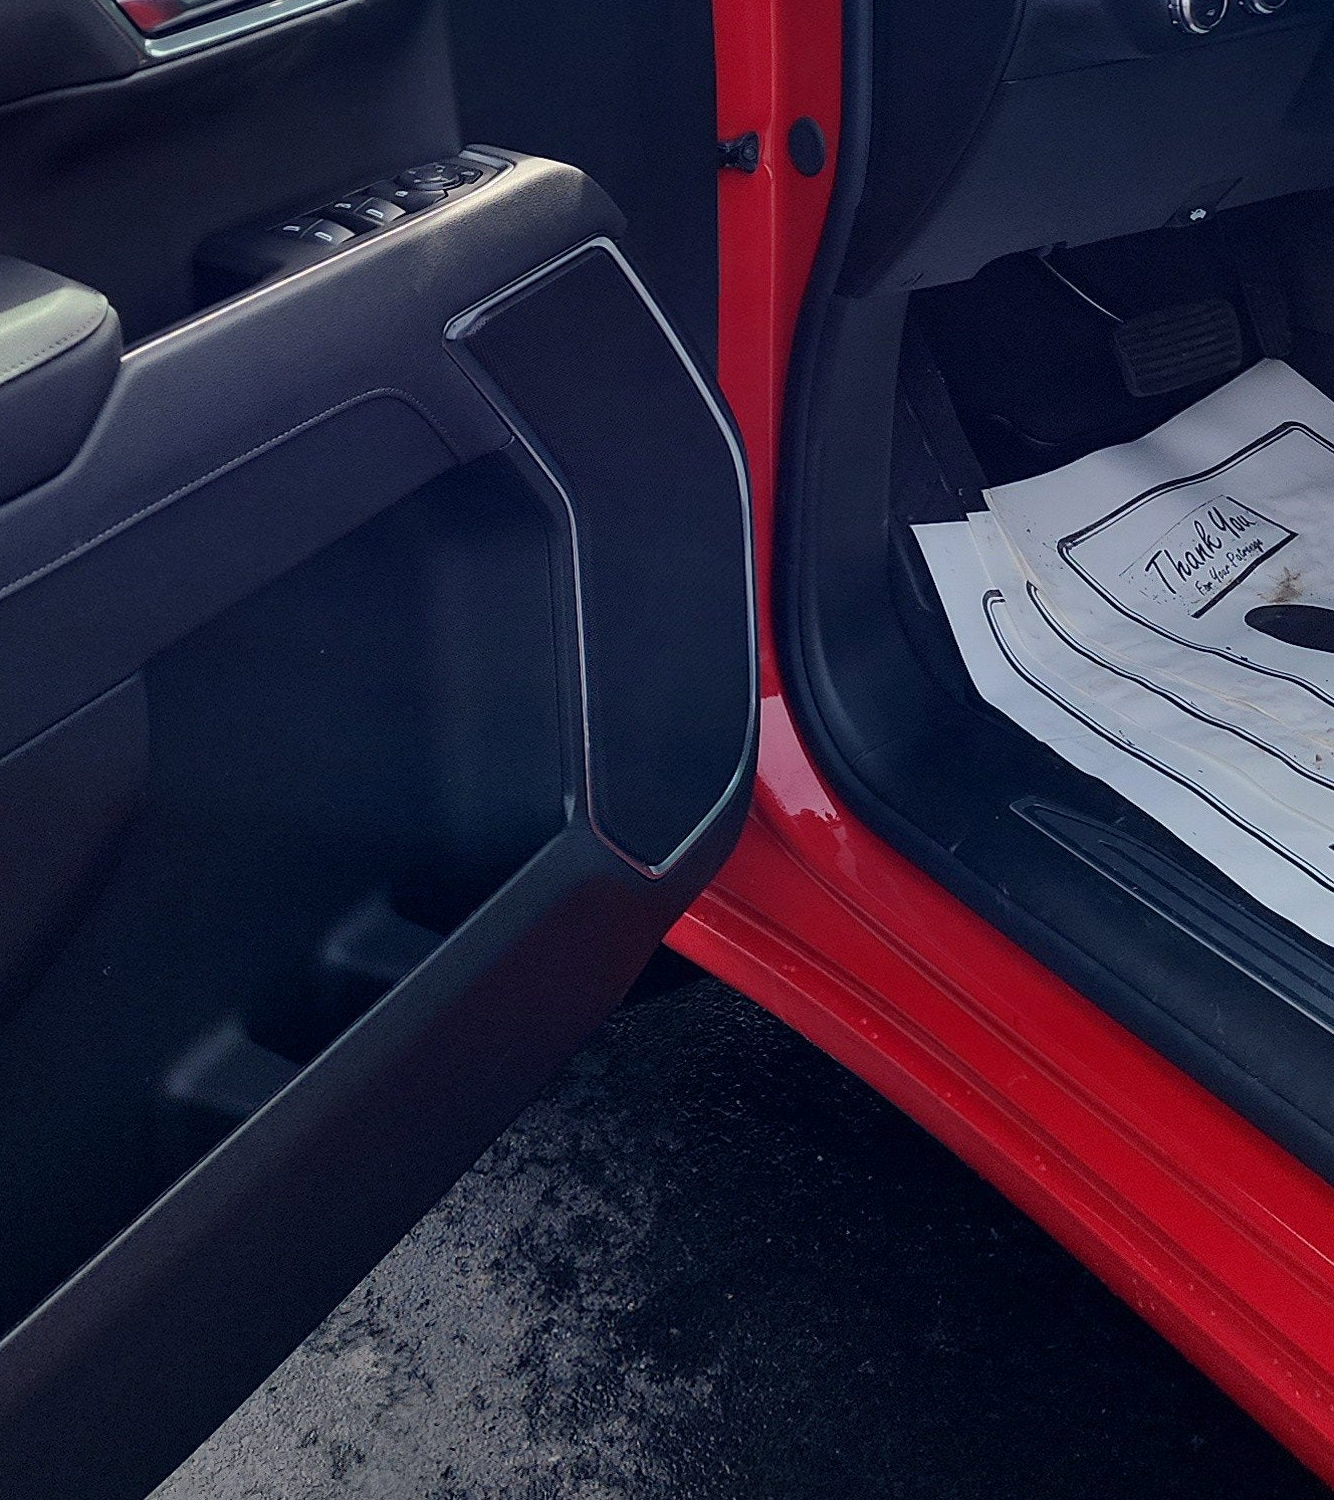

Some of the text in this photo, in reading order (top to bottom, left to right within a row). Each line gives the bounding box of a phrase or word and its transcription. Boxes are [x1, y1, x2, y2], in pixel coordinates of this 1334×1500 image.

[1145, 506, 1257, 595] Thank You
[1209, 565, 1230, 583] Your
